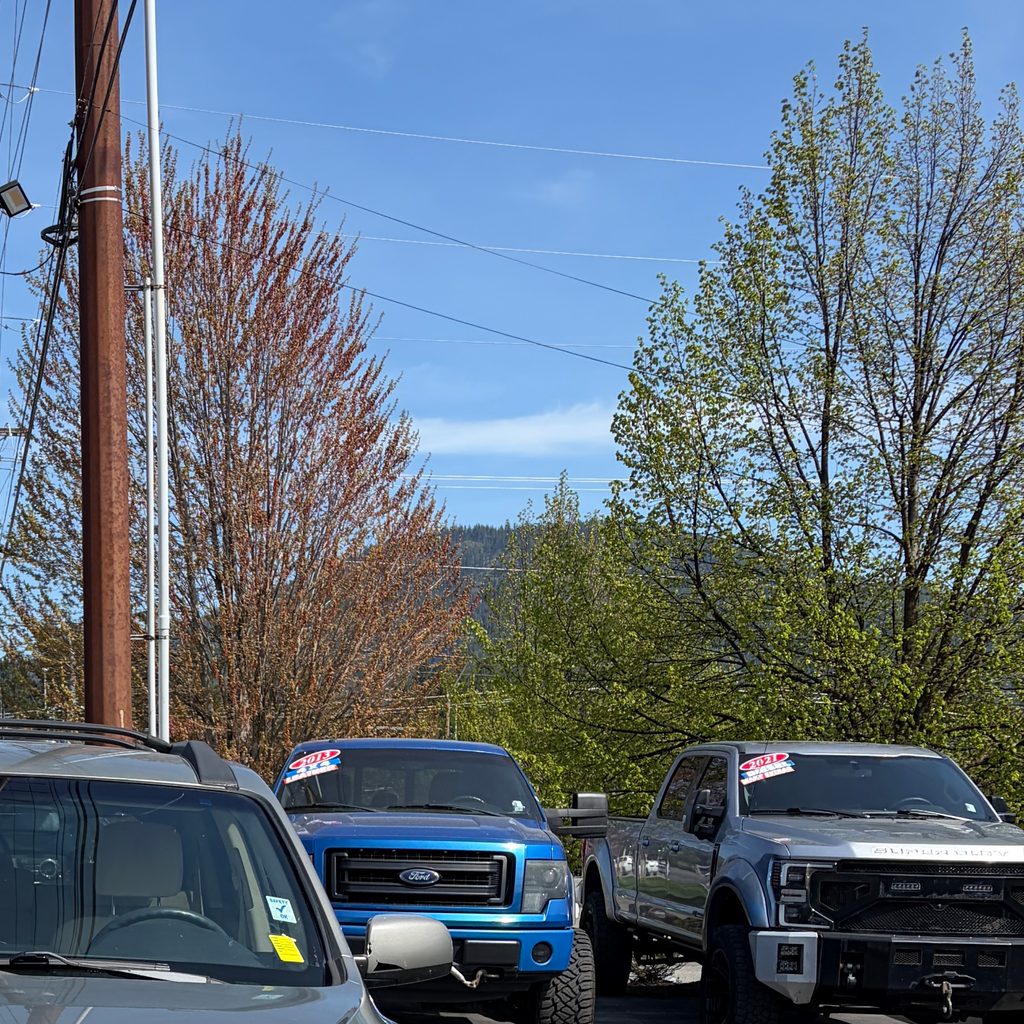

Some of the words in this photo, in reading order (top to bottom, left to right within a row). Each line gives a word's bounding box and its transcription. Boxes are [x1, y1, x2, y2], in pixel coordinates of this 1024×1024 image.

[300, 751, 330, 769] 2013
[749, 754, 777, 769] 2021
[408, 871, 431, 881] Ford
